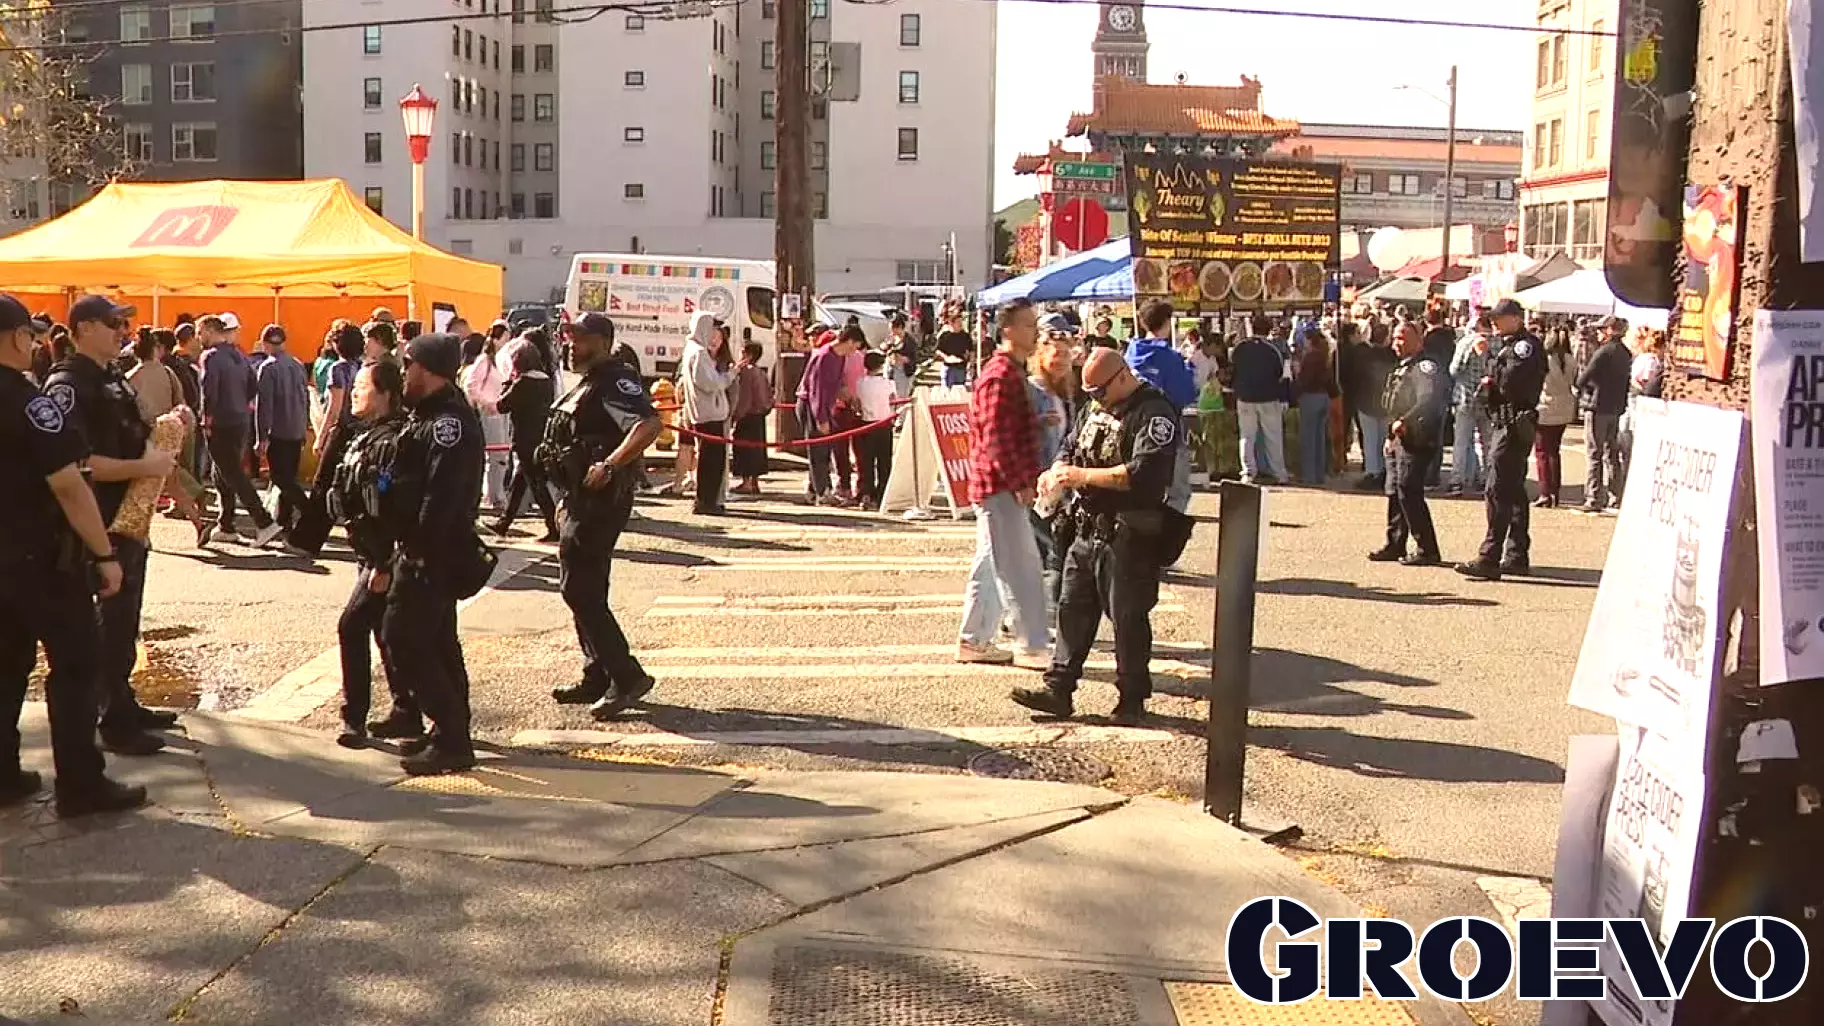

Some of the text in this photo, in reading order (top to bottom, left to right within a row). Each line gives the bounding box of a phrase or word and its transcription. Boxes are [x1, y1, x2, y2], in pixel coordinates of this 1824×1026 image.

[1156, 188, 1205, 211] Theary
[1160, 229, 1173, 242] Of
[937, 413, 970, 436] TOSS
[951, 438, 968, 456] TO
[946, 458, 971, 482] WI
